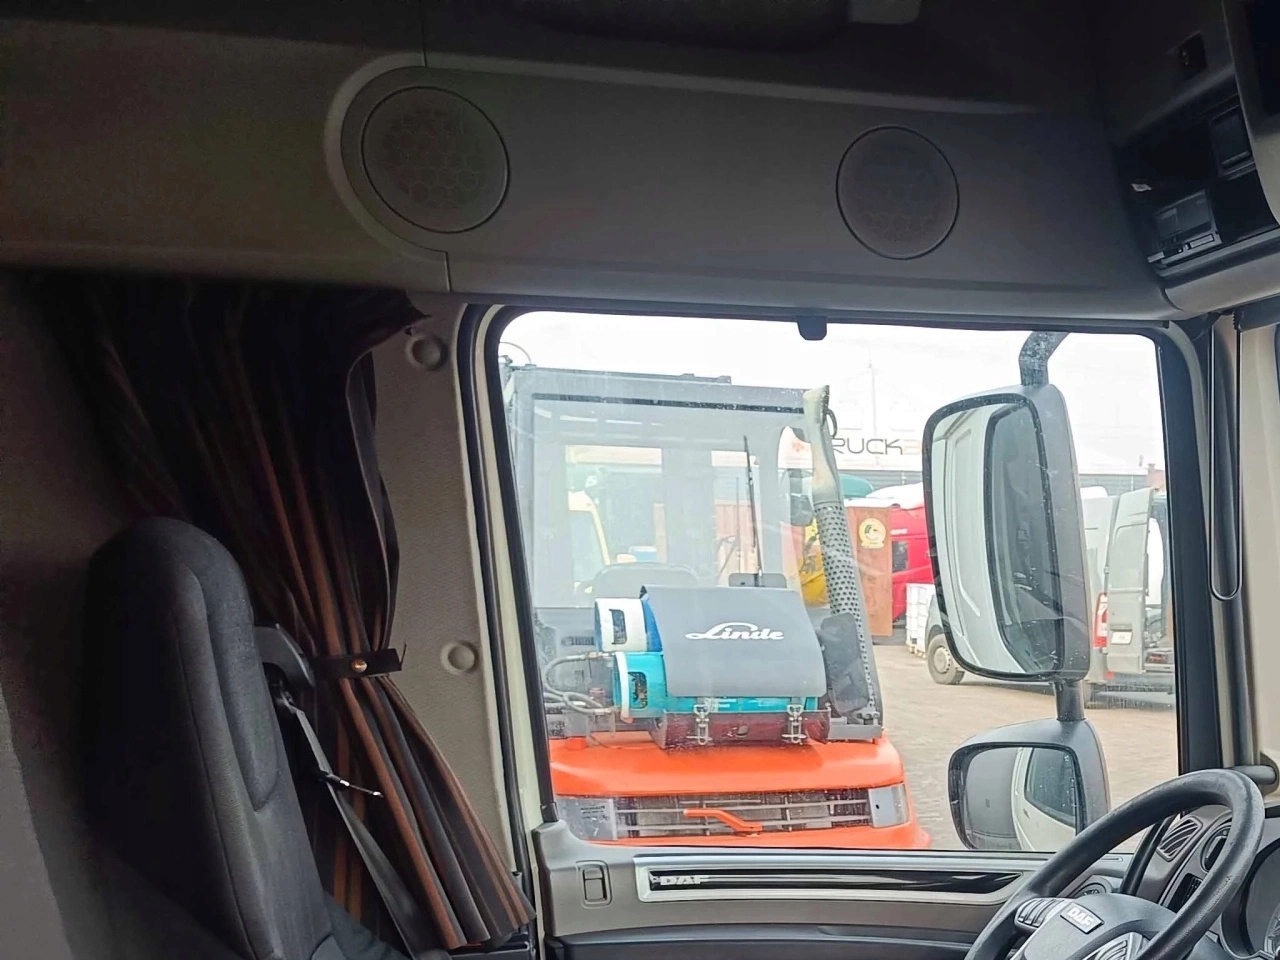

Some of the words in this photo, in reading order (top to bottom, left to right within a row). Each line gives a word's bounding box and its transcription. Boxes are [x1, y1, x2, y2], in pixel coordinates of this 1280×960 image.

[685, 621, 784, 640] Linde
[660, 874, 710, 886] DAF
[1066, 906, 1095, 926] DAF
